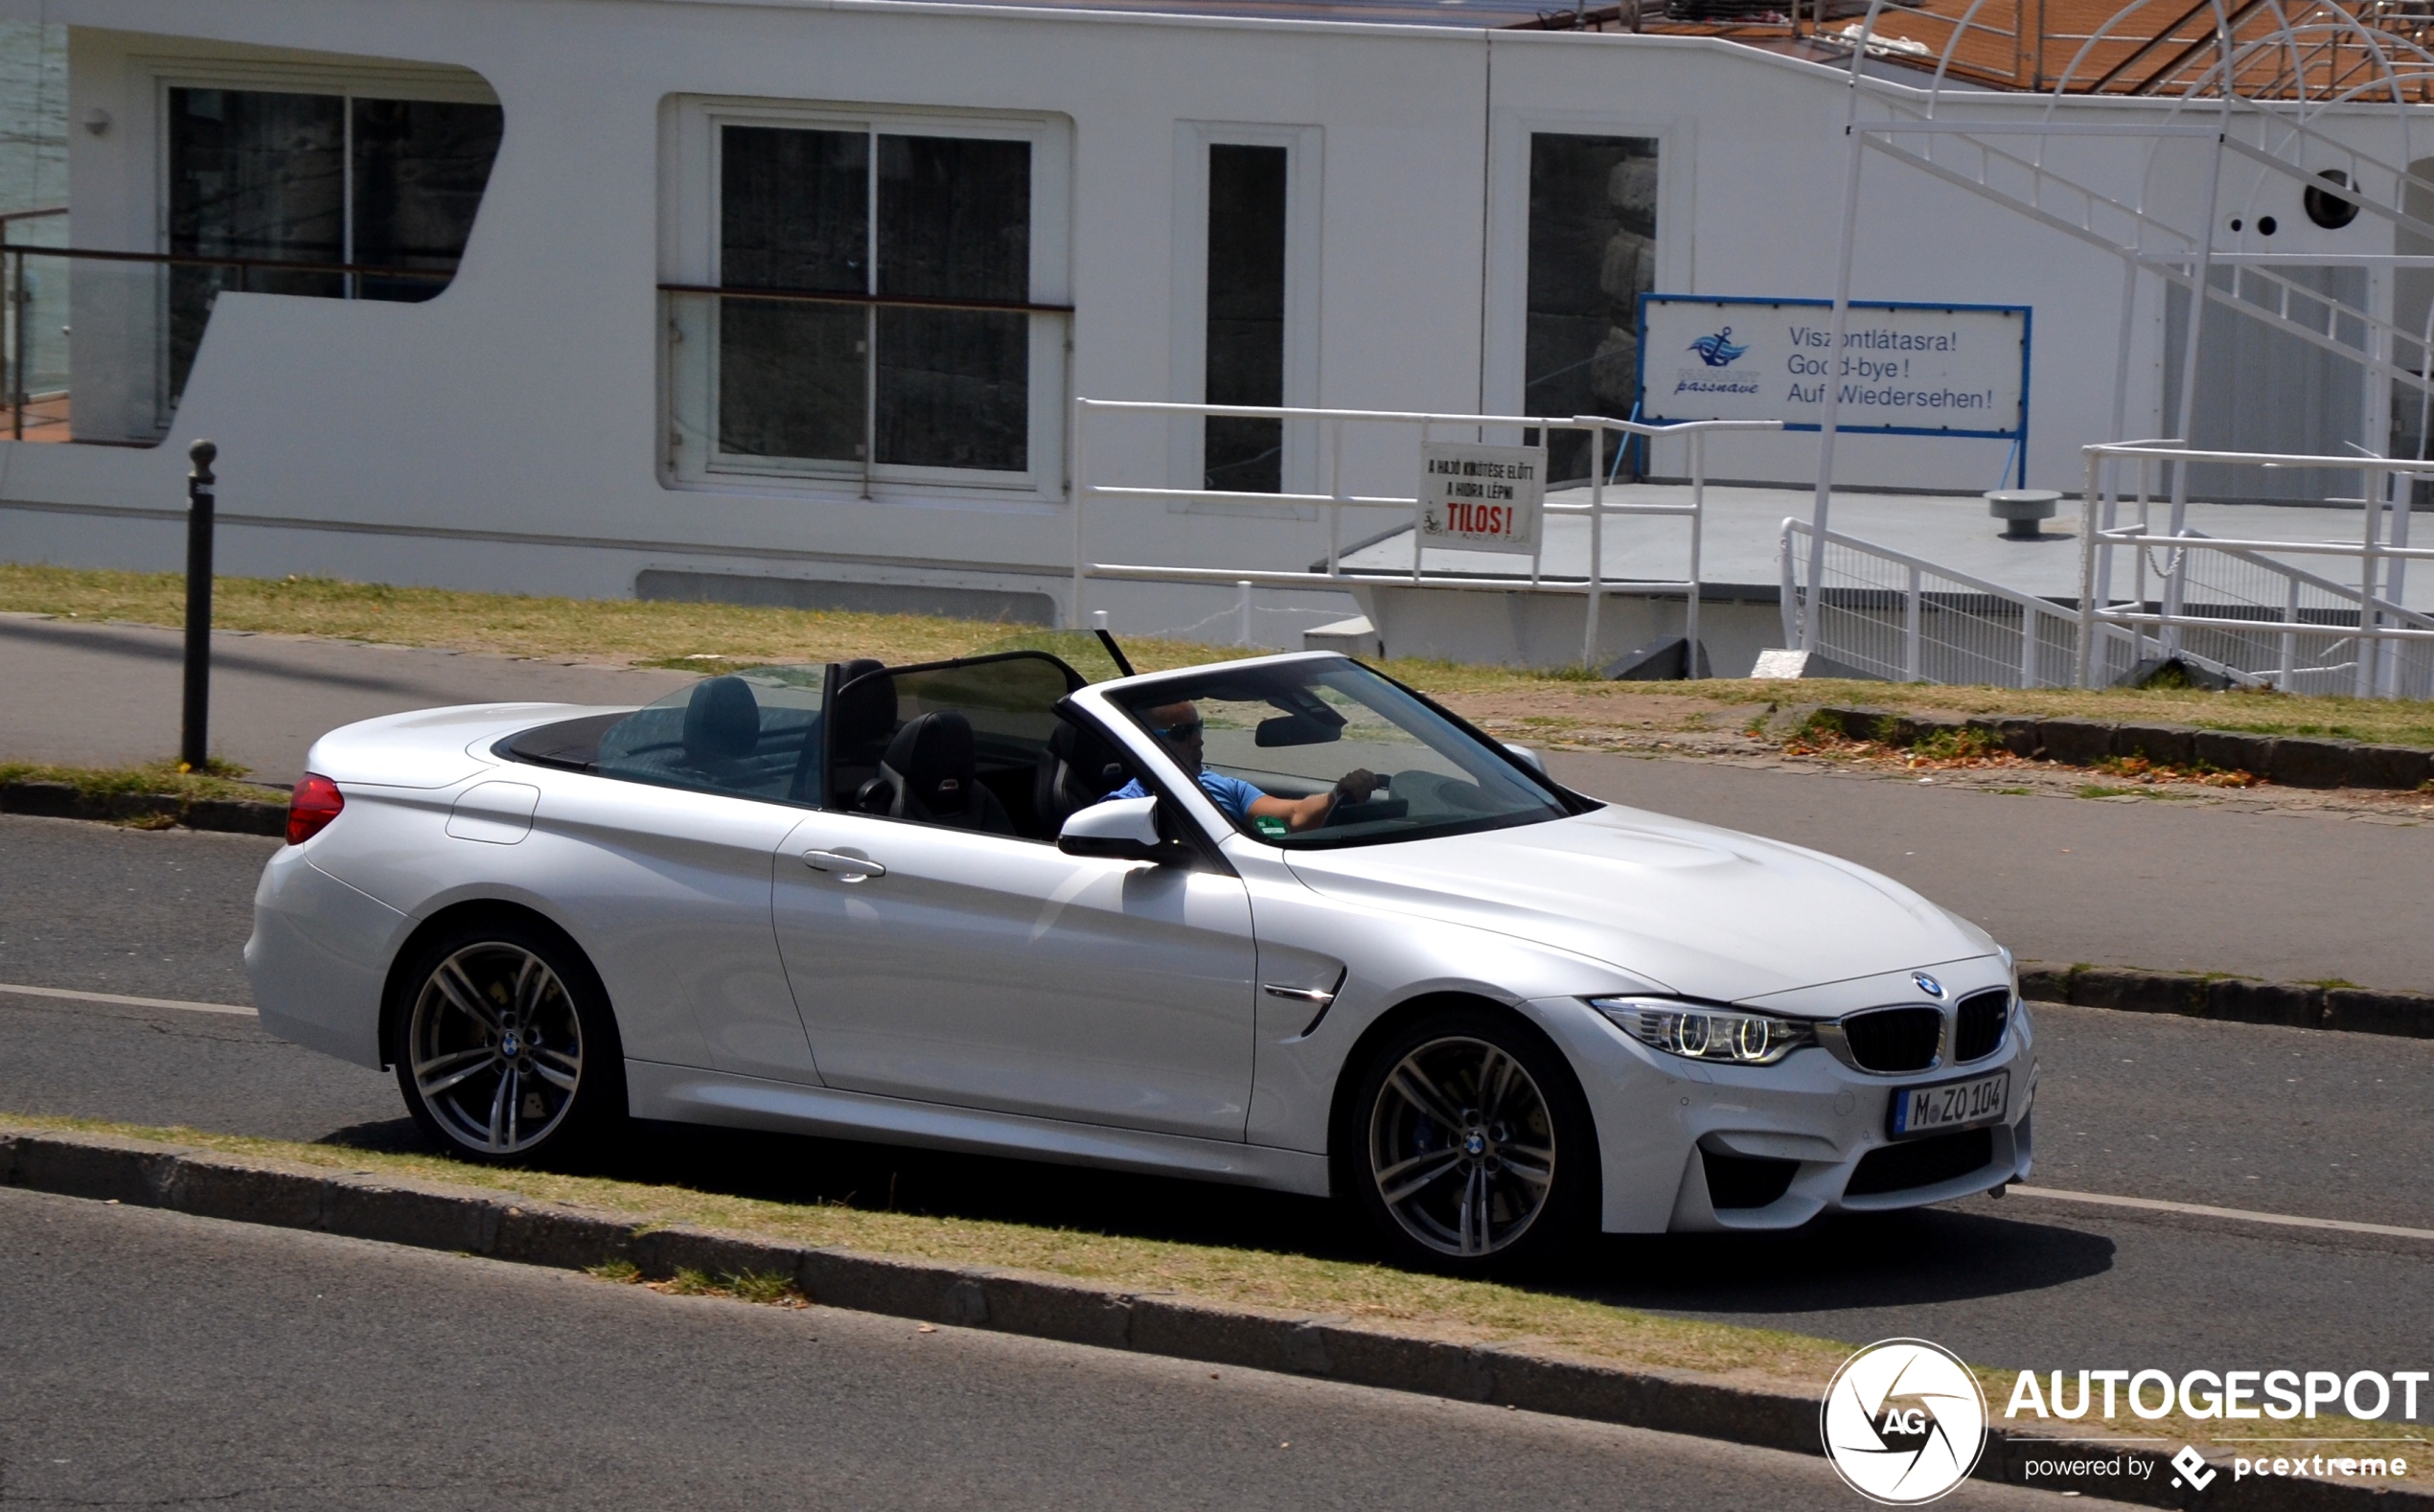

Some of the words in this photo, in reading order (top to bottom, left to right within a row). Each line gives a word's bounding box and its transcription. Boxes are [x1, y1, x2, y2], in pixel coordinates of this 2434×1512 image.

[1787, 383, 1826, 402] Auf
[1838, 384, 1992, 409] Wiedersehen!
[1428, 459, 1435, 473] A
[1446, 481, 1453, 495] A
[1447, 502, 1512, 535] TILOS!
[1914, 1092, 1930, 1126] M
[1941, 1087, 1966, 1122] ZO
[1969, 1079, 2001, 1116] 104
